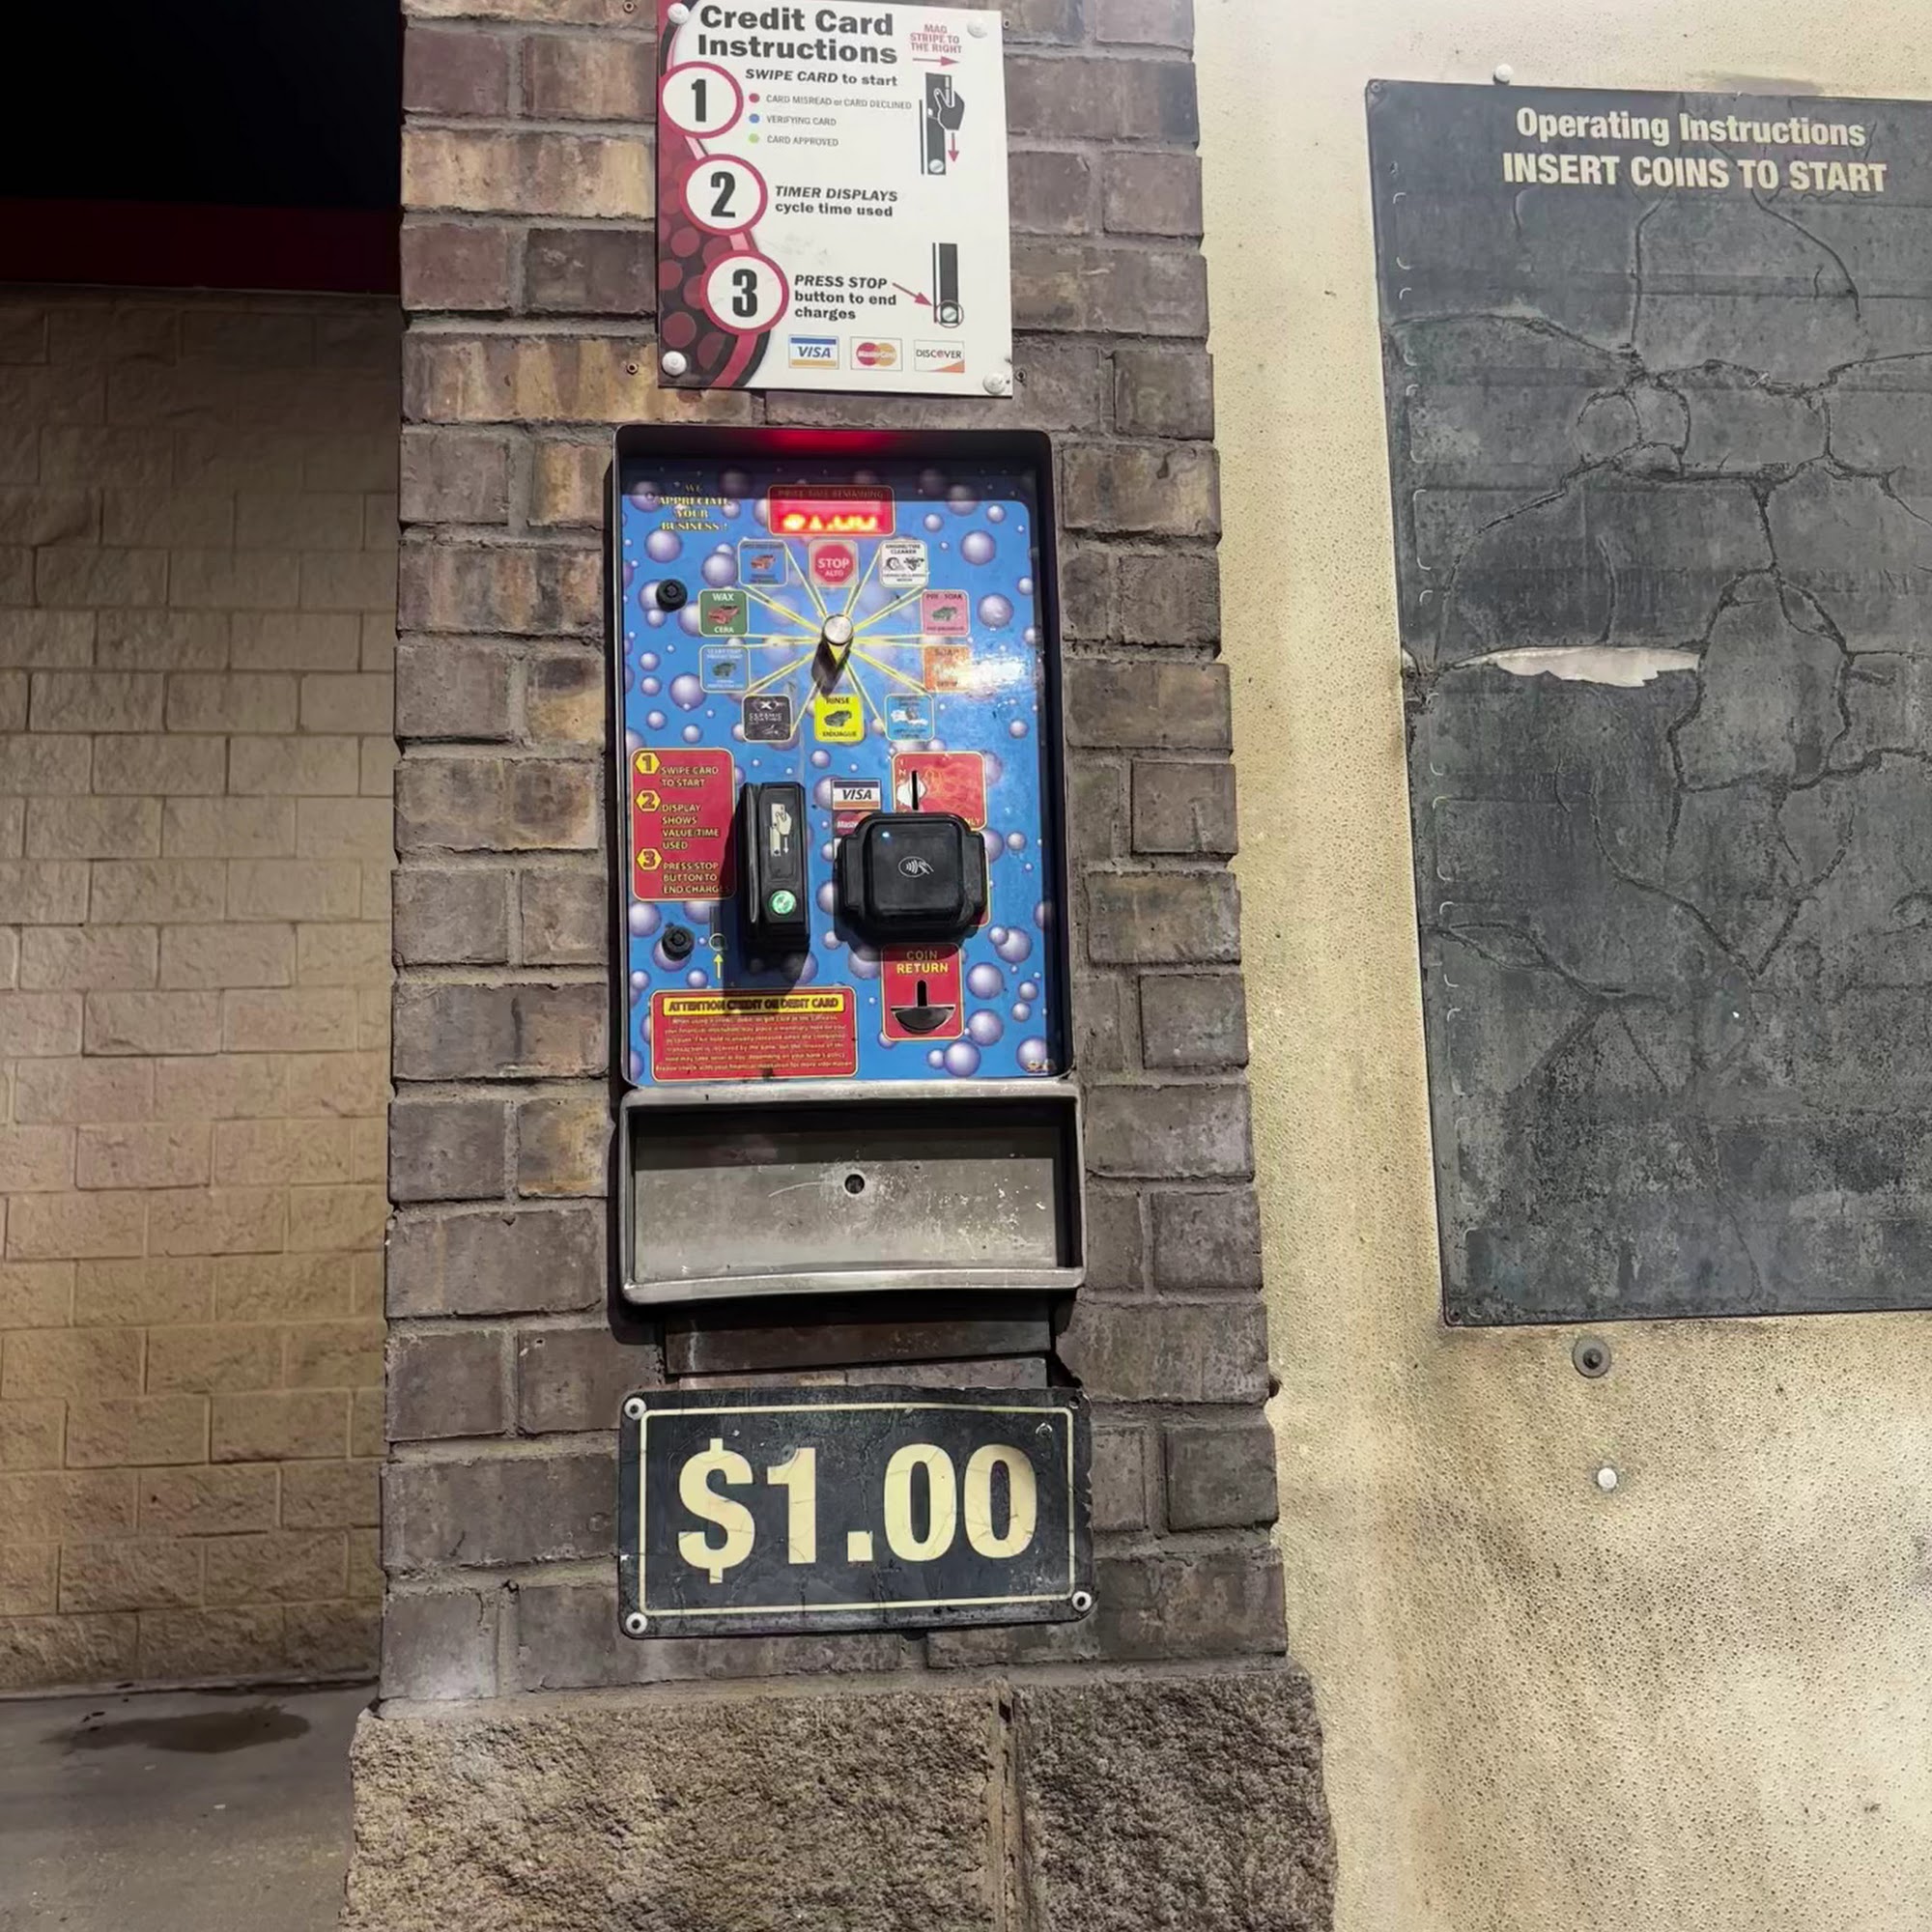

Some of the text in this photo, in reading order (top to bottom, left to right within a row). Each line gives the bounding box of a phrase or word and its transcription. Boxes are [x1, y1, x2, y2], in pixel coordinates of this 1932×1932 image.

[700, 5, 894, 36] Credit Card
[924, 24, 948, 34] MAG
[910, 32, 960, 44] STRIPE TO
[698, 34, 897, 64] Instructions
[911, 43, 962, 53] THE RIGHT
[746, 69, 897, 86] SWIPE CARD to start
[691, 78, 707, 123] 1
[766, 95, 790, 103] CARD
[792, 96, 832, 105] MISREAD
[844, 98, 867, 107] CARD
[869, 99, 912, 109] DECLINED
[767, 115, 837, 126] VERIFYING CARD
[1517, 106, 1866, 148] Operating Instructions
[767, 135, 838, 146] CARD APPROVED
[1502, 153, 1888, 192] INSERT COINS TO START
[710, 171, 736, 218] 2
[776, 185, 898, 202] TIMER DISPLAYS
[776, 203, 893, 216] cycle time used
[794, 274, 887, 289] PRESS STOP
[732, 269, 757, 318] 3
[794, 291, 896, 305] button to end
[794, 308, 856, 321] charges
[798, 346, 832, 358] VISA
[916, 349, 962, 358] DISCOVER
[676, 509, 708, 519] YOUR
[817, 557, 850, 569] STOP
[826, 696, 849, 705] RINSE
[641, 754, 651, 772] 1
[662, 766, 719, 775] SWIPE CARD
[641, 792, 656, 810] 2
[842, 789, 872, 800] VISA
[662, 804, 701, 812] DISPLAY
[642, 850, 656, 867] 3
[906, 951, 937, 960] COIN
[896, 963, 948, 974] RETURN
[668, 1000, 724, 1011] ATTENTION
[811, 997, 839, 1008] CARD
[678, 1437, 1037, 1584] $1.00
